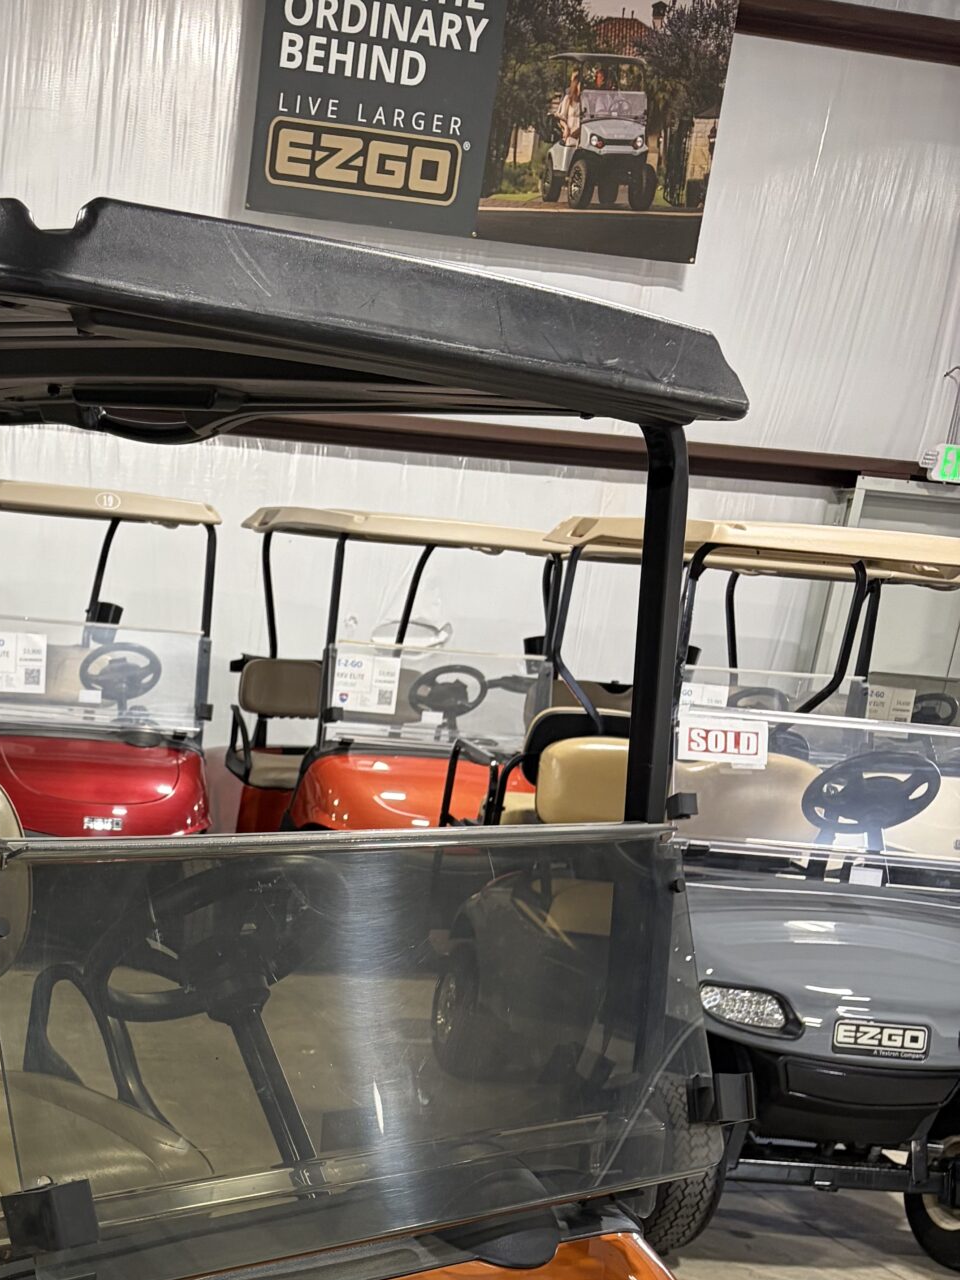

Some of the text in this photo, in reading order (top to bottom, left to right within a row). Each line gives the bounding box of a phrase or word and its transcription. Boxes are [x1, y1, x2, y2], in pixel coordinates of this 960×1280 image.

[284, 0, 490, 53] ORDINARY
[279, 31, 427, 87] BEHIND
[278, 92, 462, 136] LIVE LARGER
[689, 728, 758, 756] SOLD
[836, 1024, 926, 1049] EZGO
[900, 1051, 926, 1060] Company
